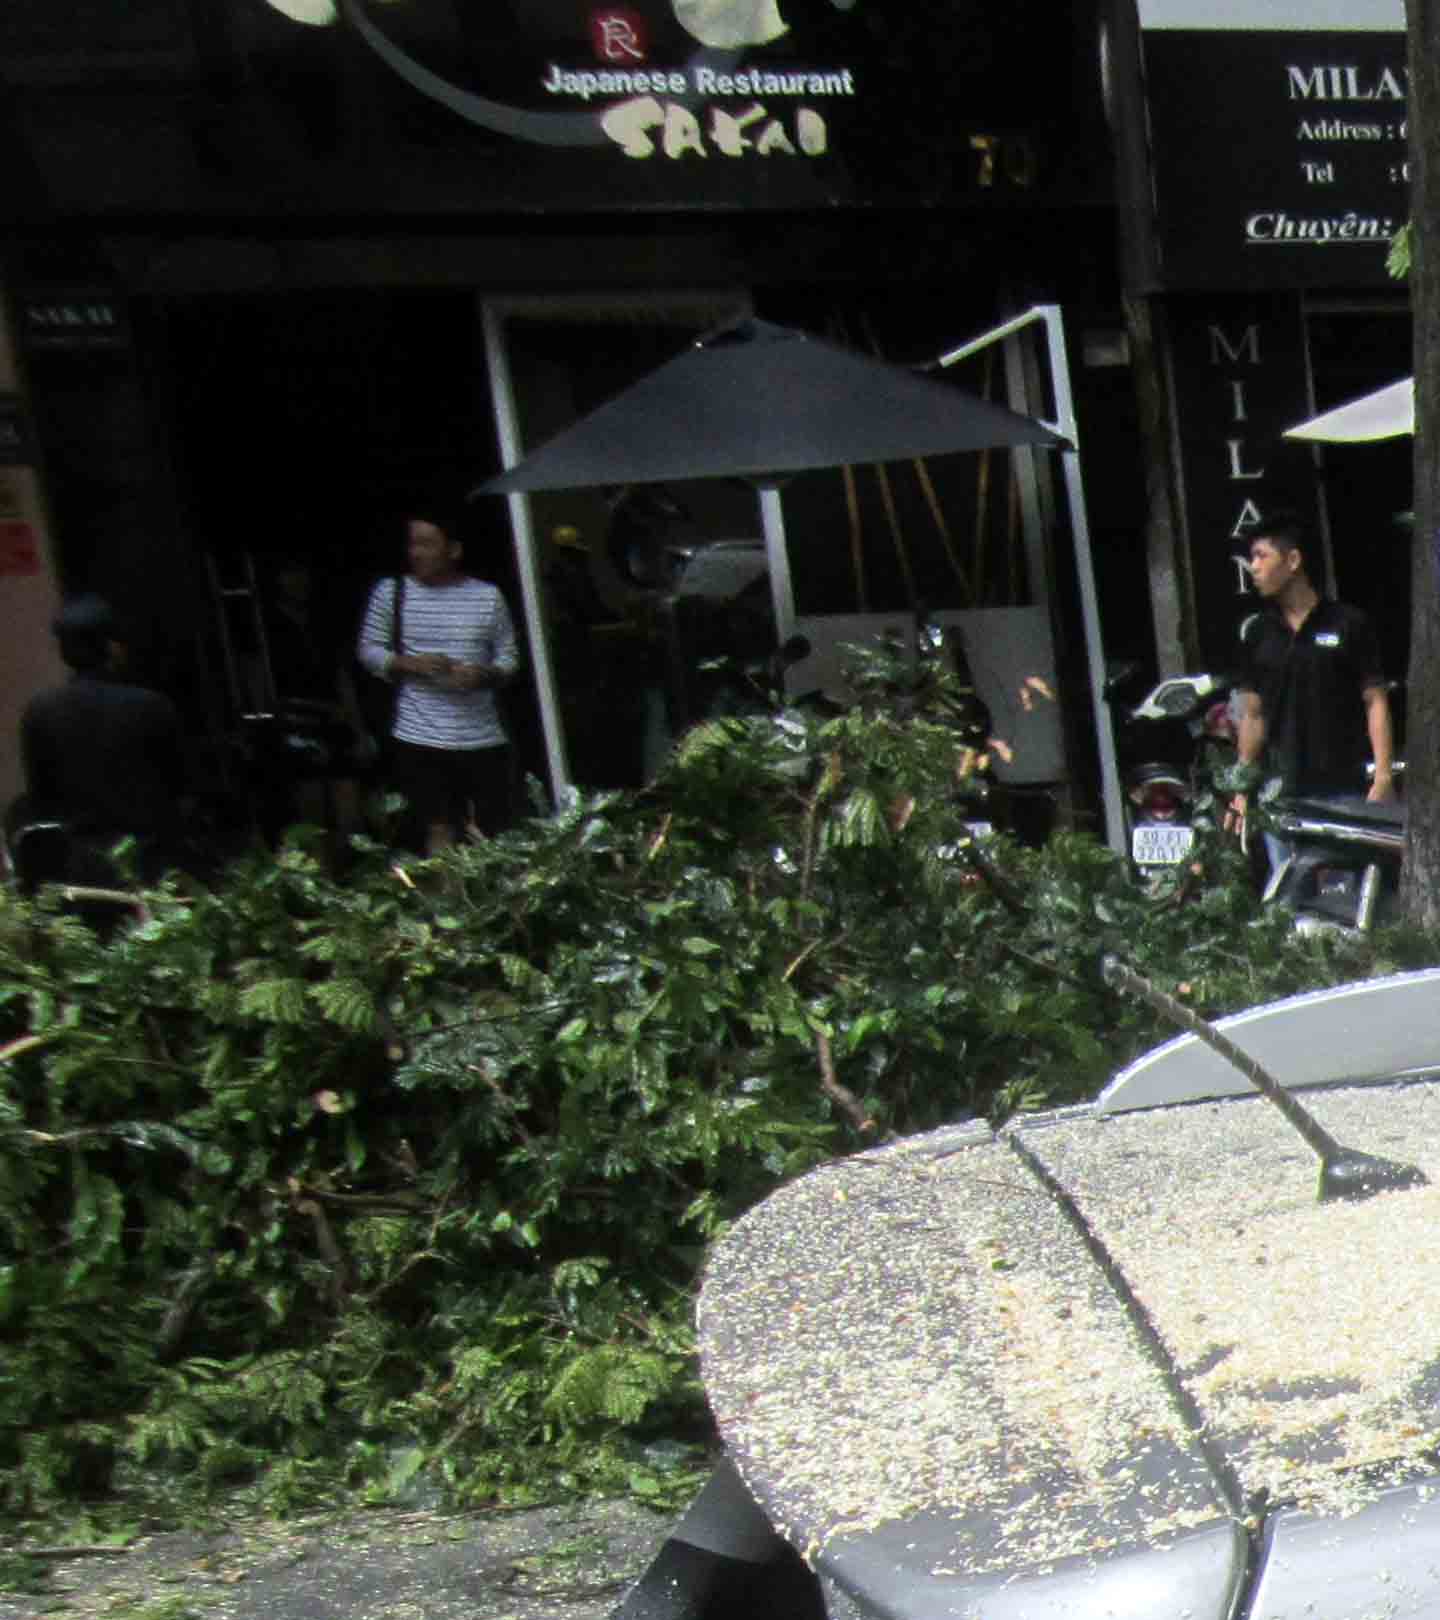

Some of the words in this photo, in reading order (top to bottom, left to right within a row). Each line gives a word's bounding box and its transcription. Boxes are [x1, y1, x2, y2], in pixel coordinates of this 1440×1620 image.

[543, 66, 686, 99] Japanese
[696, 68, 855, 96] Restaurant
[1284, 65, 1408, 101] MILA
[1297, 119, 1383, 141] Address
[1302, 161, 1335, 184] Tel
